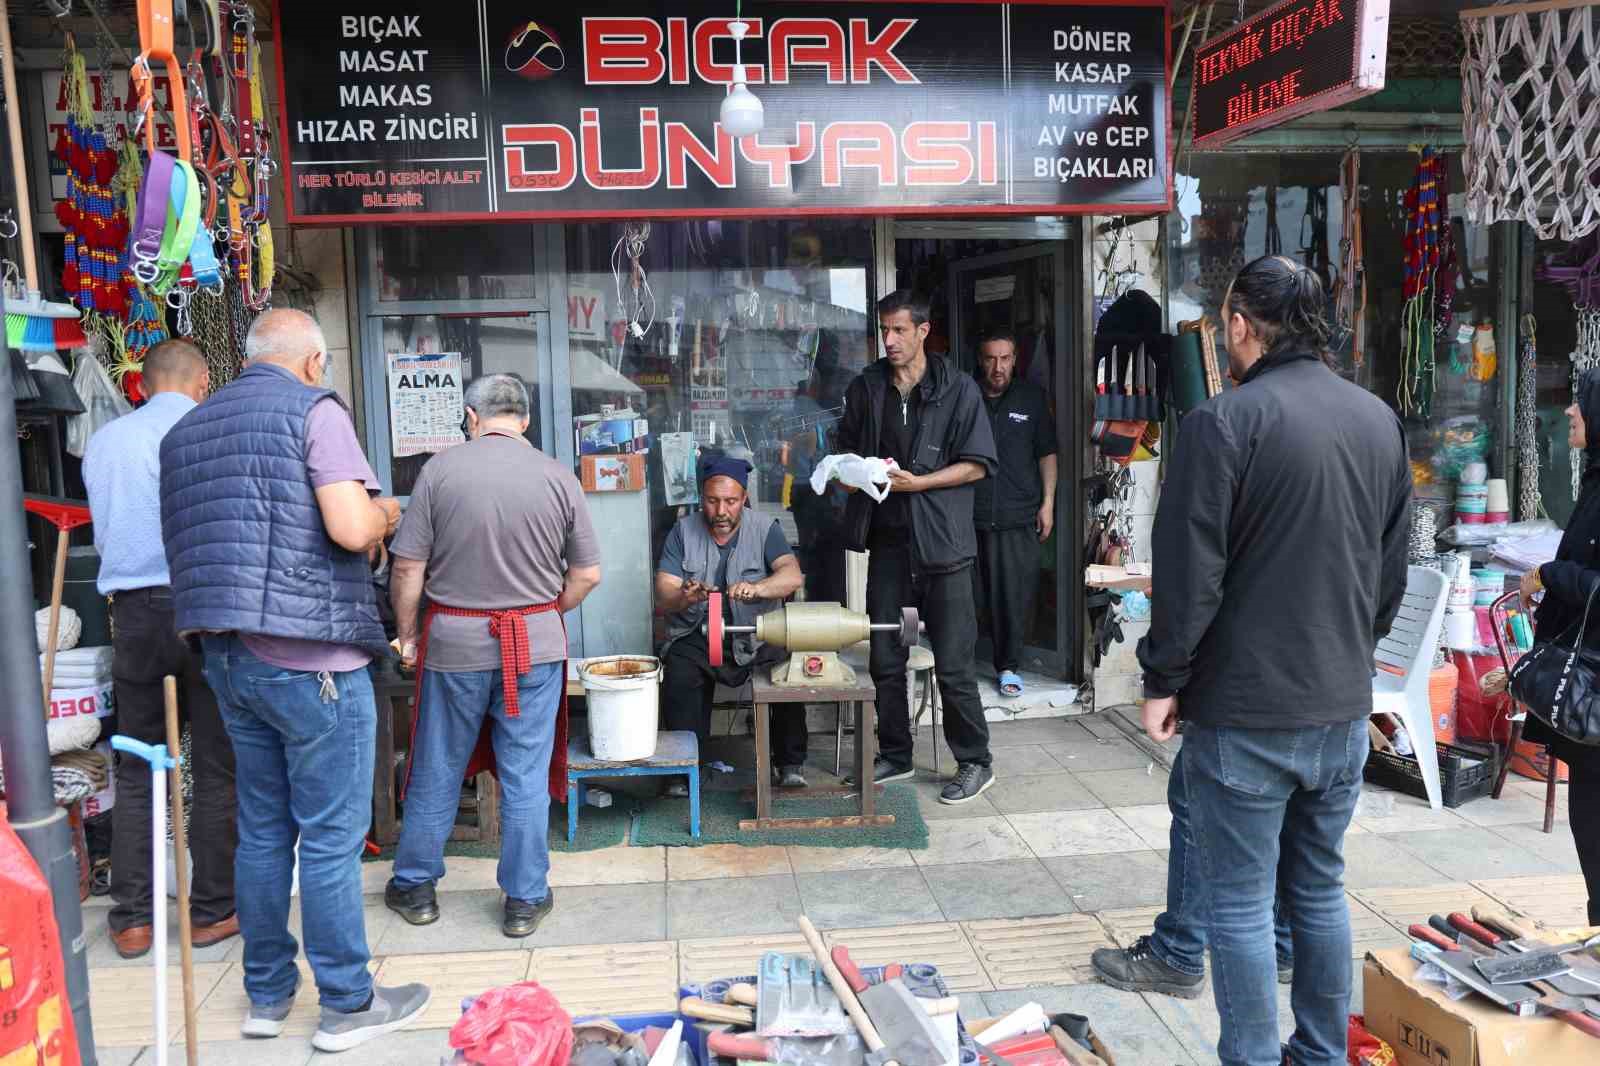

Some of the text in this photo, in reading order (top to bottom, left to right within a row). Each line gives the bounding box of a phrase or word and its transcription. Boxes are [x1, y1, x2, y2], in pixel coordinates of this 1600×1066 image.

[342, 15, 422, 43] BIÇAK
[1053, 25, 1131, 53] DÖNER
[582, 17, 921, 88] BIÇAK
[1201, 0, 1345, 86] TEKNİK BIÇAK
[340, 49, 429, 73] MASAT
[1055, 62, 1131, 83] KASAP
[340, 84, 432, 108] MAKAS
[1048, 94, 1139, 116] MUTFAK
[1227, 69, 1305, 128] BİLEME
[297, 112, 478, 144] HIZAR ZİNCİRİ
[1038, 126, 1149, 147] AV ve CEP
[502, 107, 998, 190] DÜNYASI
[298, 168, 482, 188] HER TÜRLÜ KESİCİ ALET
[1033, 156, 1155, 183] BIÇAKLARI
[362, 190, 423, 208] BİLENİR
[398, 374, 456, 389] ALMA
